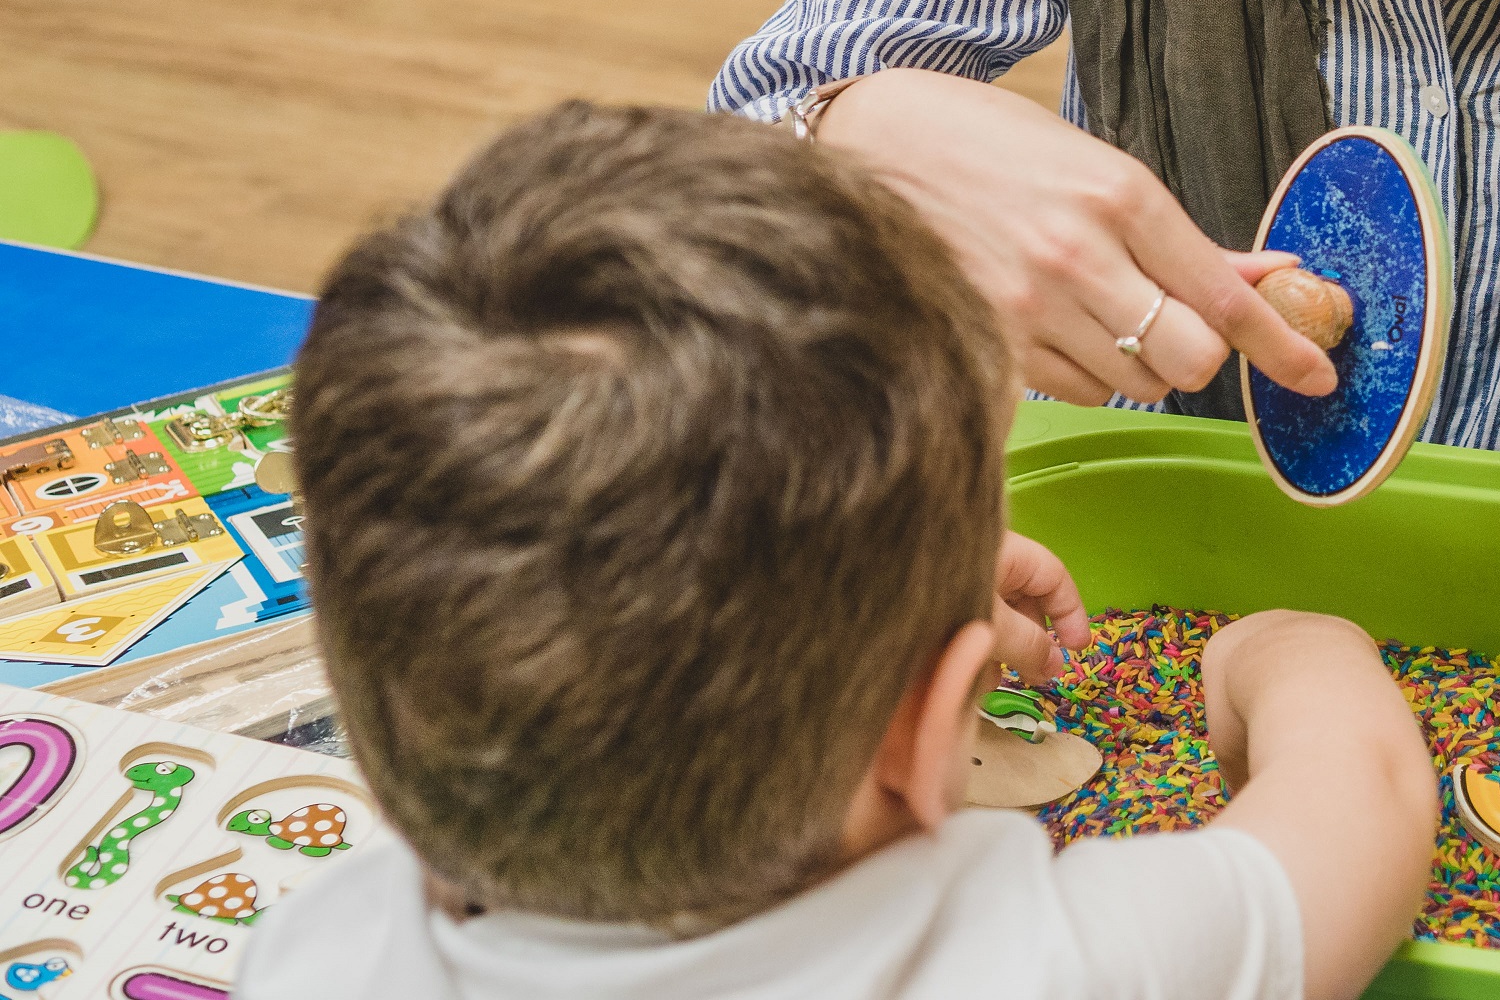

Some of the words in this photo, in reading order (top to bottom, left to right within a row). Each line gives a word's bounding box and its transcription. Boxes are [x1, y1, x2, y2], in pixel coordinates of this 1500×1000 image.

[1388, 295, 1407, 343] Oval
[57, 617, 107, 643] 3
[22, 892, 91, 921] one
[158, 921, 229, 954] two
